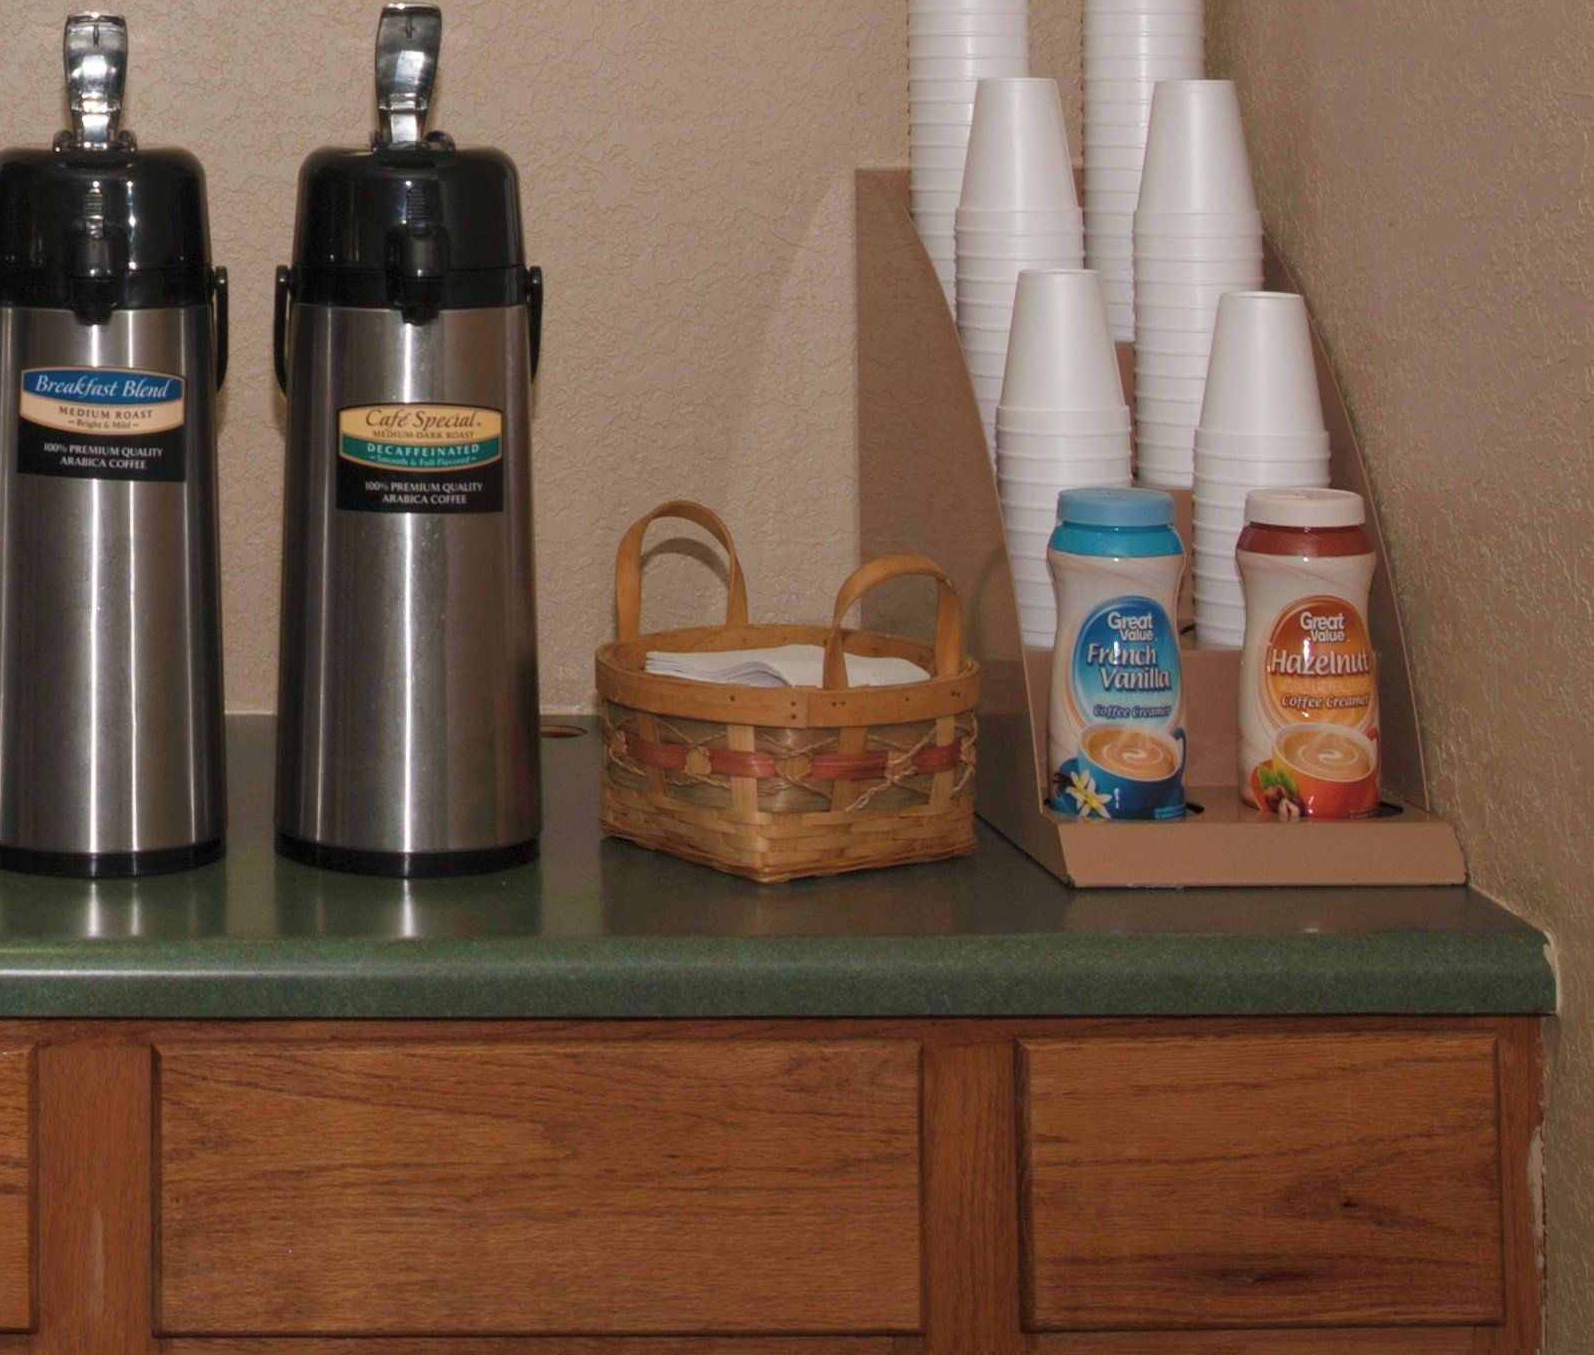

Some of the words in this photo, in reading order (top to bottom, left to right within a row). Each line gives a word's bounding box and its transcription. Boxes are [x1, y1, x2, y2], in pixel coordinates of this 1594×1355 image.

[35, 374, 119, 399] Breakfast
[122, 377, 174, 399] Blend
[59, 406, 110, 419] MEDIUM
[115, 409, 153, 420] ROAST
[366, 408, 411, 431] Café
[413, 410, 477, 431] Special
[446, 431, 474, 439] ROAST
[69, 444, 119, 456] PREMIUM
[121, 447, 163, 458] QUALITY
[367, 443, 480, 457] DECAFFEINATED
[60, 456, 106, 467] ARABICA
[108, 458, 147, 469] COFFEE
[391, 482, 440, 492] PREMIUM
[442, 482, 483, 494] QUALITY
[382, 494, 428, 504] ARABICA
[430, 495, 467, 504] COFFEE
[1107, 610, 1154, 630] Great
[1300, 611, 1345, 631] Great
[1119, 629, 1154, 642] Value
[1310, 629, 1345, 642] Value
[1086, 643, 1157, 666] French
[1270, 648, 1370, 676] Hazelnut
[1100, 666, 1171, 690] Vanilla
[1281, 693, 1323, 709] Coffee
[1093, 704, 1130, 718] Coffee
